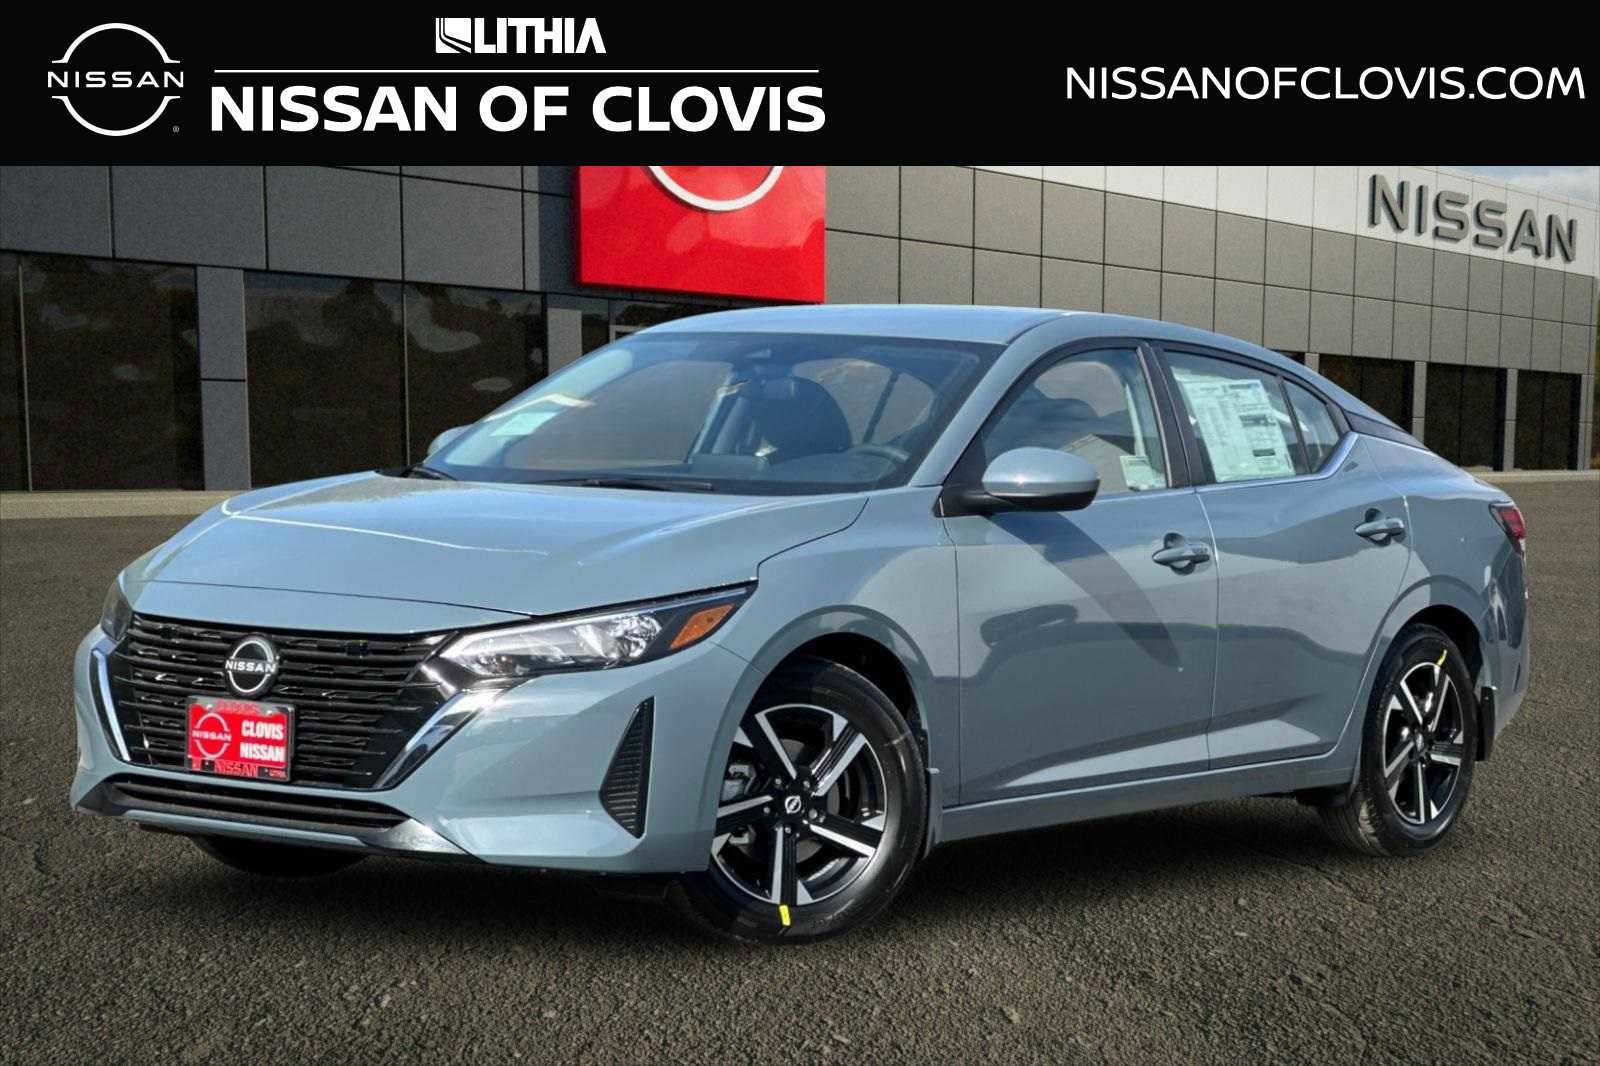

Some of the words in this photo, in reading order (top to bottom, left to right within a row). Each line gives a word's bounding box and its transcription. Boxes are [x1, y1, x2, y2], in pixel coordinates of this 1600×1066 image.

[1368, 174, 1578, 263] NISSAN
[225, 660, 276, 673] NISSAN
[192, 730, 232, 742] NISSAN
[241, 720, 284, 740] CLOVIS
[240, 742, 285, 762] NISSAN
